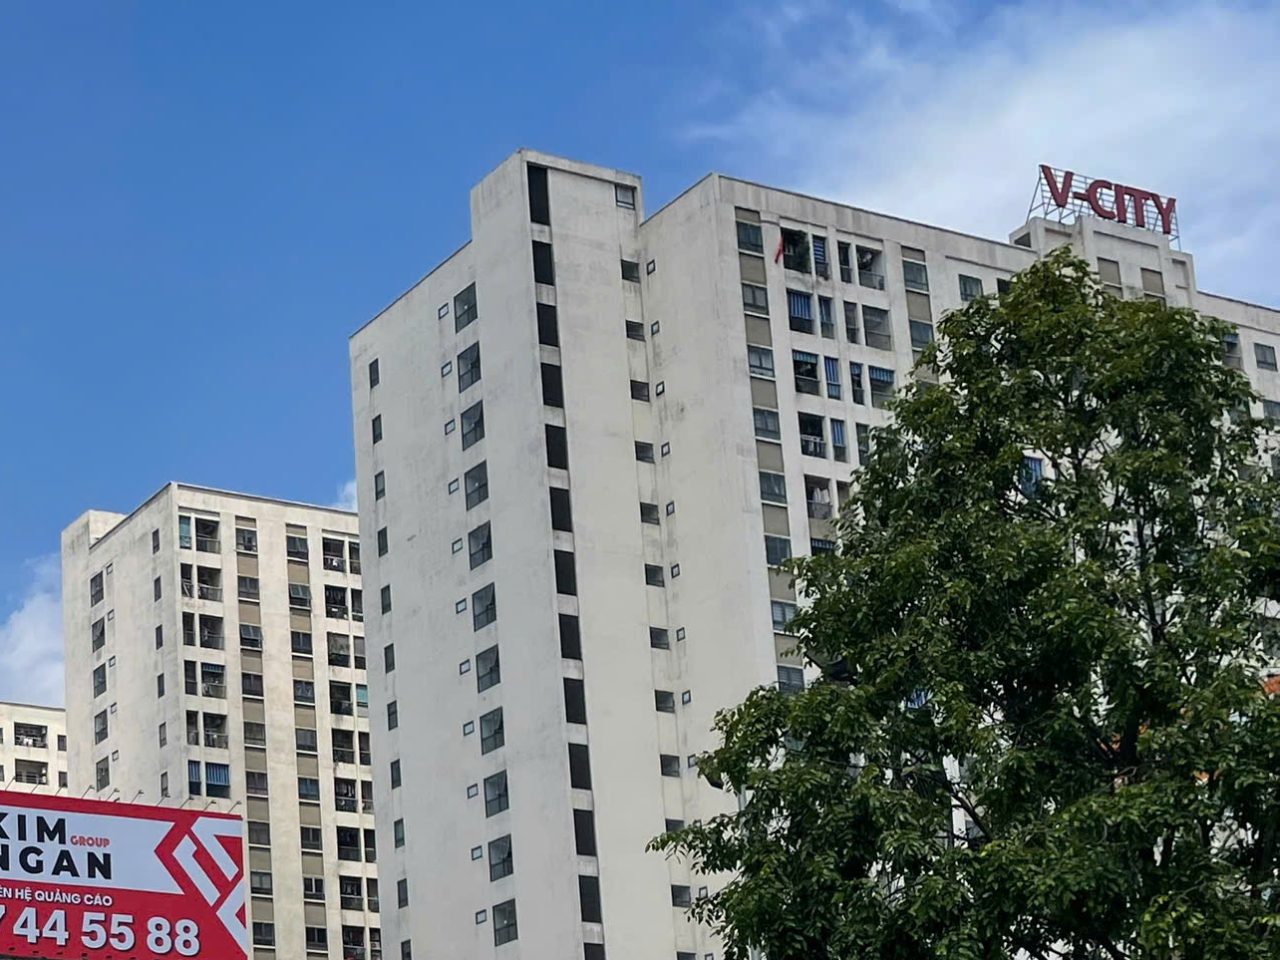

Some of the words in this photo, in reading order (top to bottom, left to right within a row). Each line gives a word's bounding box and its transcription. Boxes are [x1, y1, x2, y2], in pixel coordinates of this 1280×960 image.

[1039, 164, 1177, 234] V-CITY
[70, 835, 110, 848] GROUP
[15, 887, 32, 902] HỆ
[34, 888, 81, 904] QUẢNG
[84, 893, 113, 906] CÁO
[12, 906, 70, 946] 44
[81, 911, 135, 951] 55
[146, 916, 201, 957] 88
